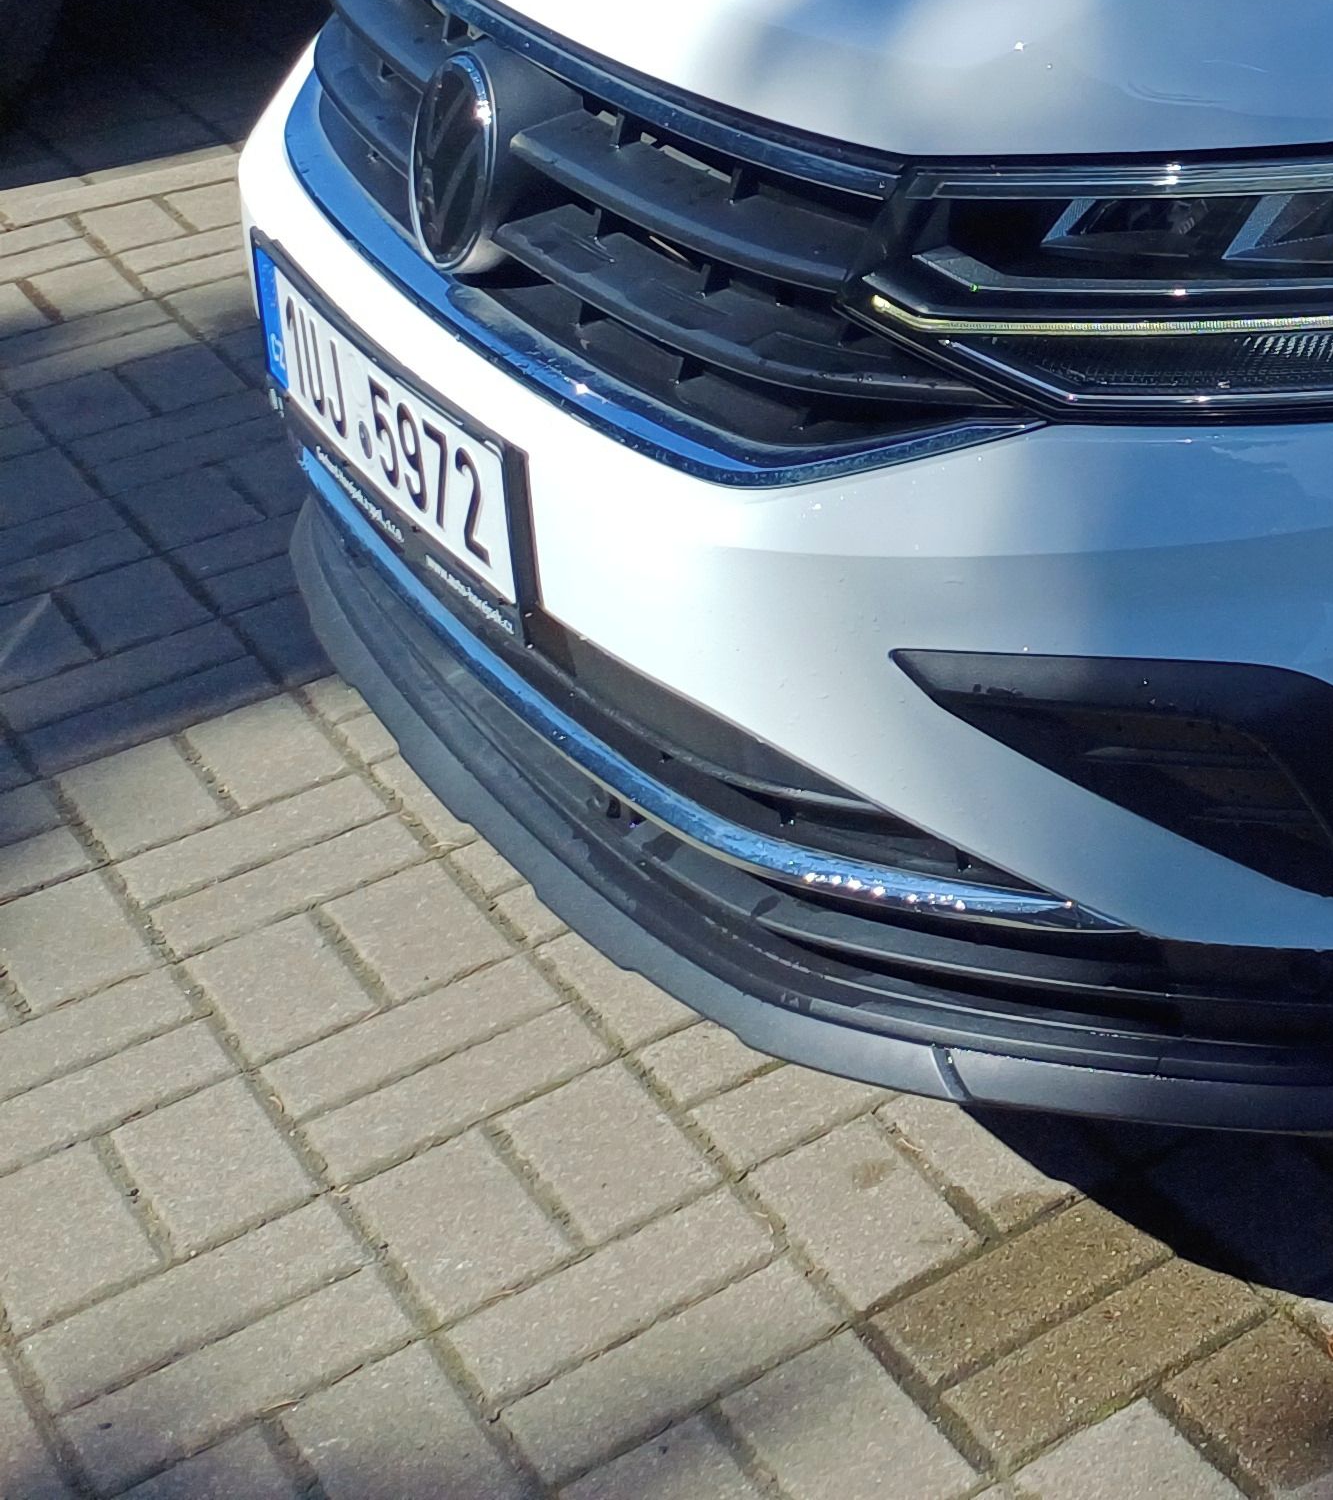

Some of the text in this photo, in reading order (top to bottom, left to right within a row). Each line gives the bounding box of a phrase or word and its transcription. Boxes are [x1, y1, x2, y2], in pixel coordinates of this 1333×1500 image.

[270, 332, 286, 371] CZ
[285, 296, 347, 439] 1UJ
[368, 374, 492, 569] 5972
